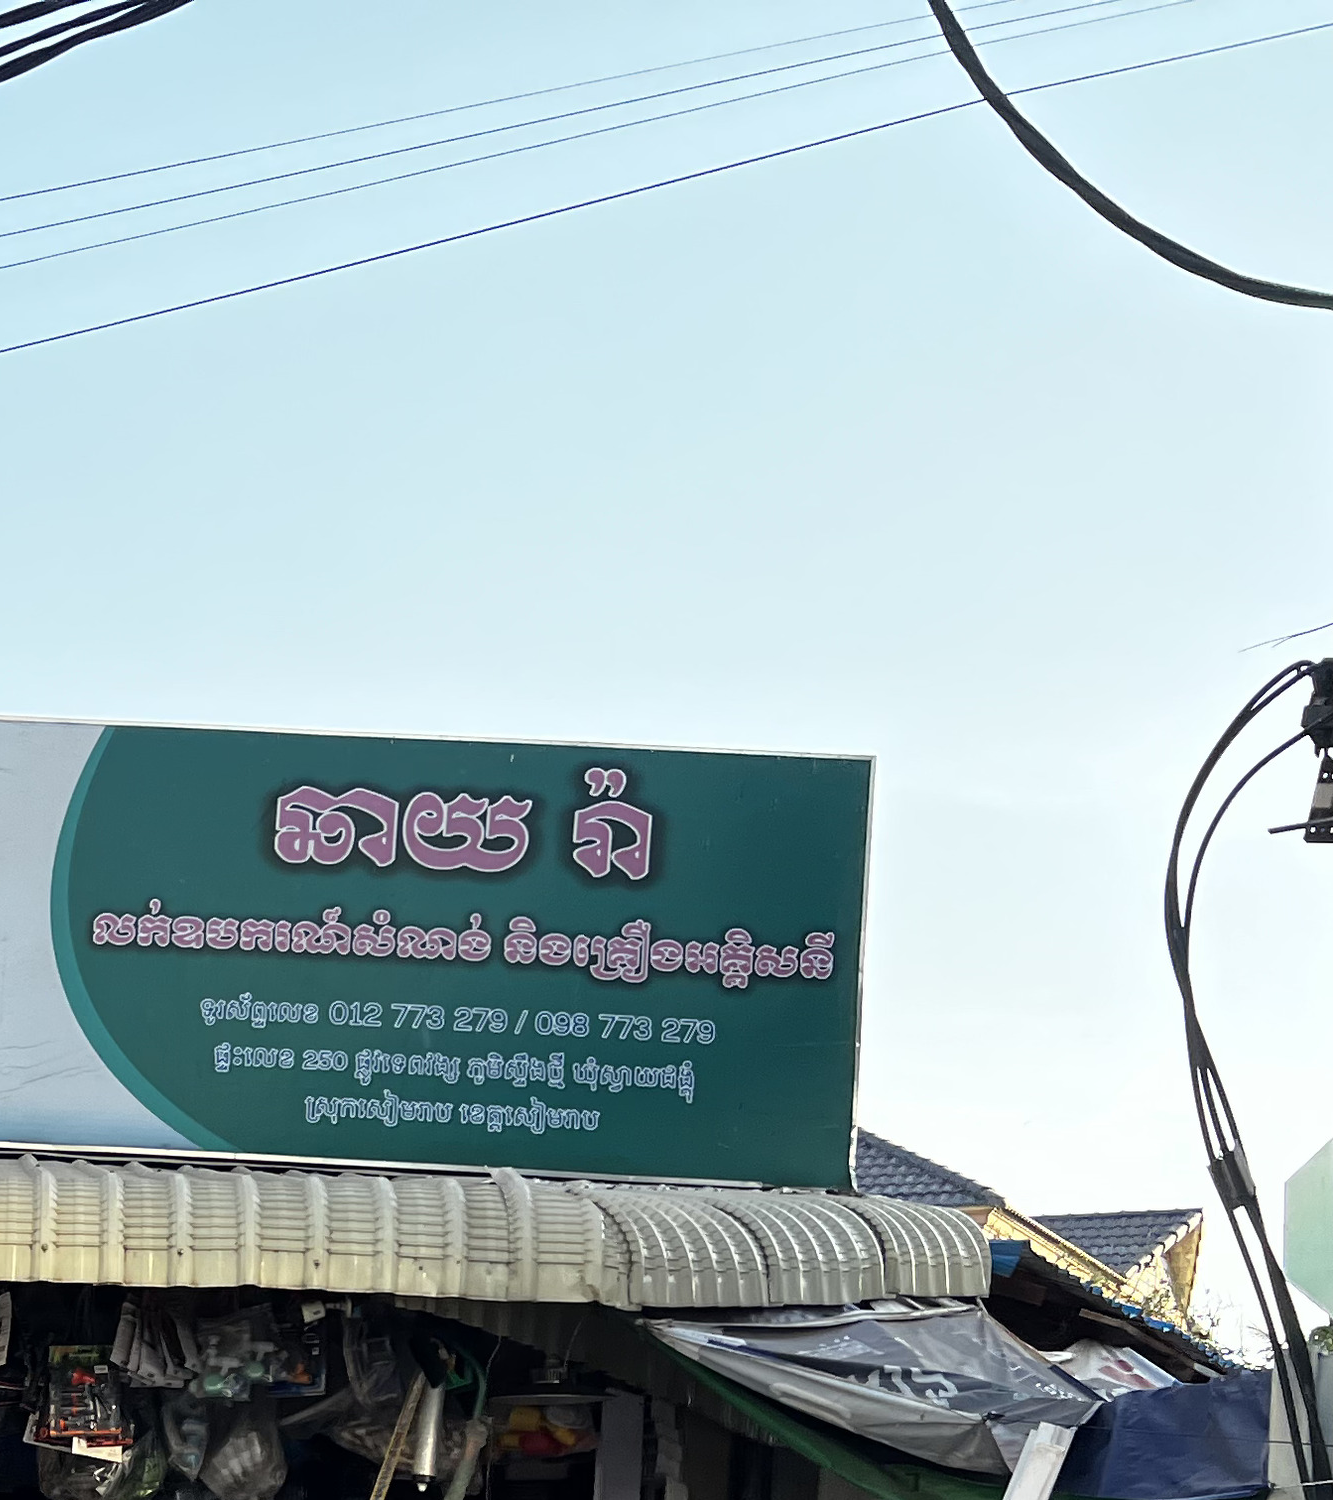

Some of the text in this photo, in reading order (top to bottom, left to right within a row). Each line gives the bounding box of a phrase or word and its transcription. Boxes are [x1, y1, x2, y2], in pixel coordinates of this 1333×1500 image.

[328, 1000, 383, 1027] 012
[390, 1002, 446, 1030] 773
[453, 1006, 509, 1034] 279
[514, 1009, 529, 1035] /
[534, 1010, 590, 1038] 098
[598, 1013, 653, 1041] 773
[661, 1018, 716, 1045] 279
[301, 1049, 348, 1071] 250
